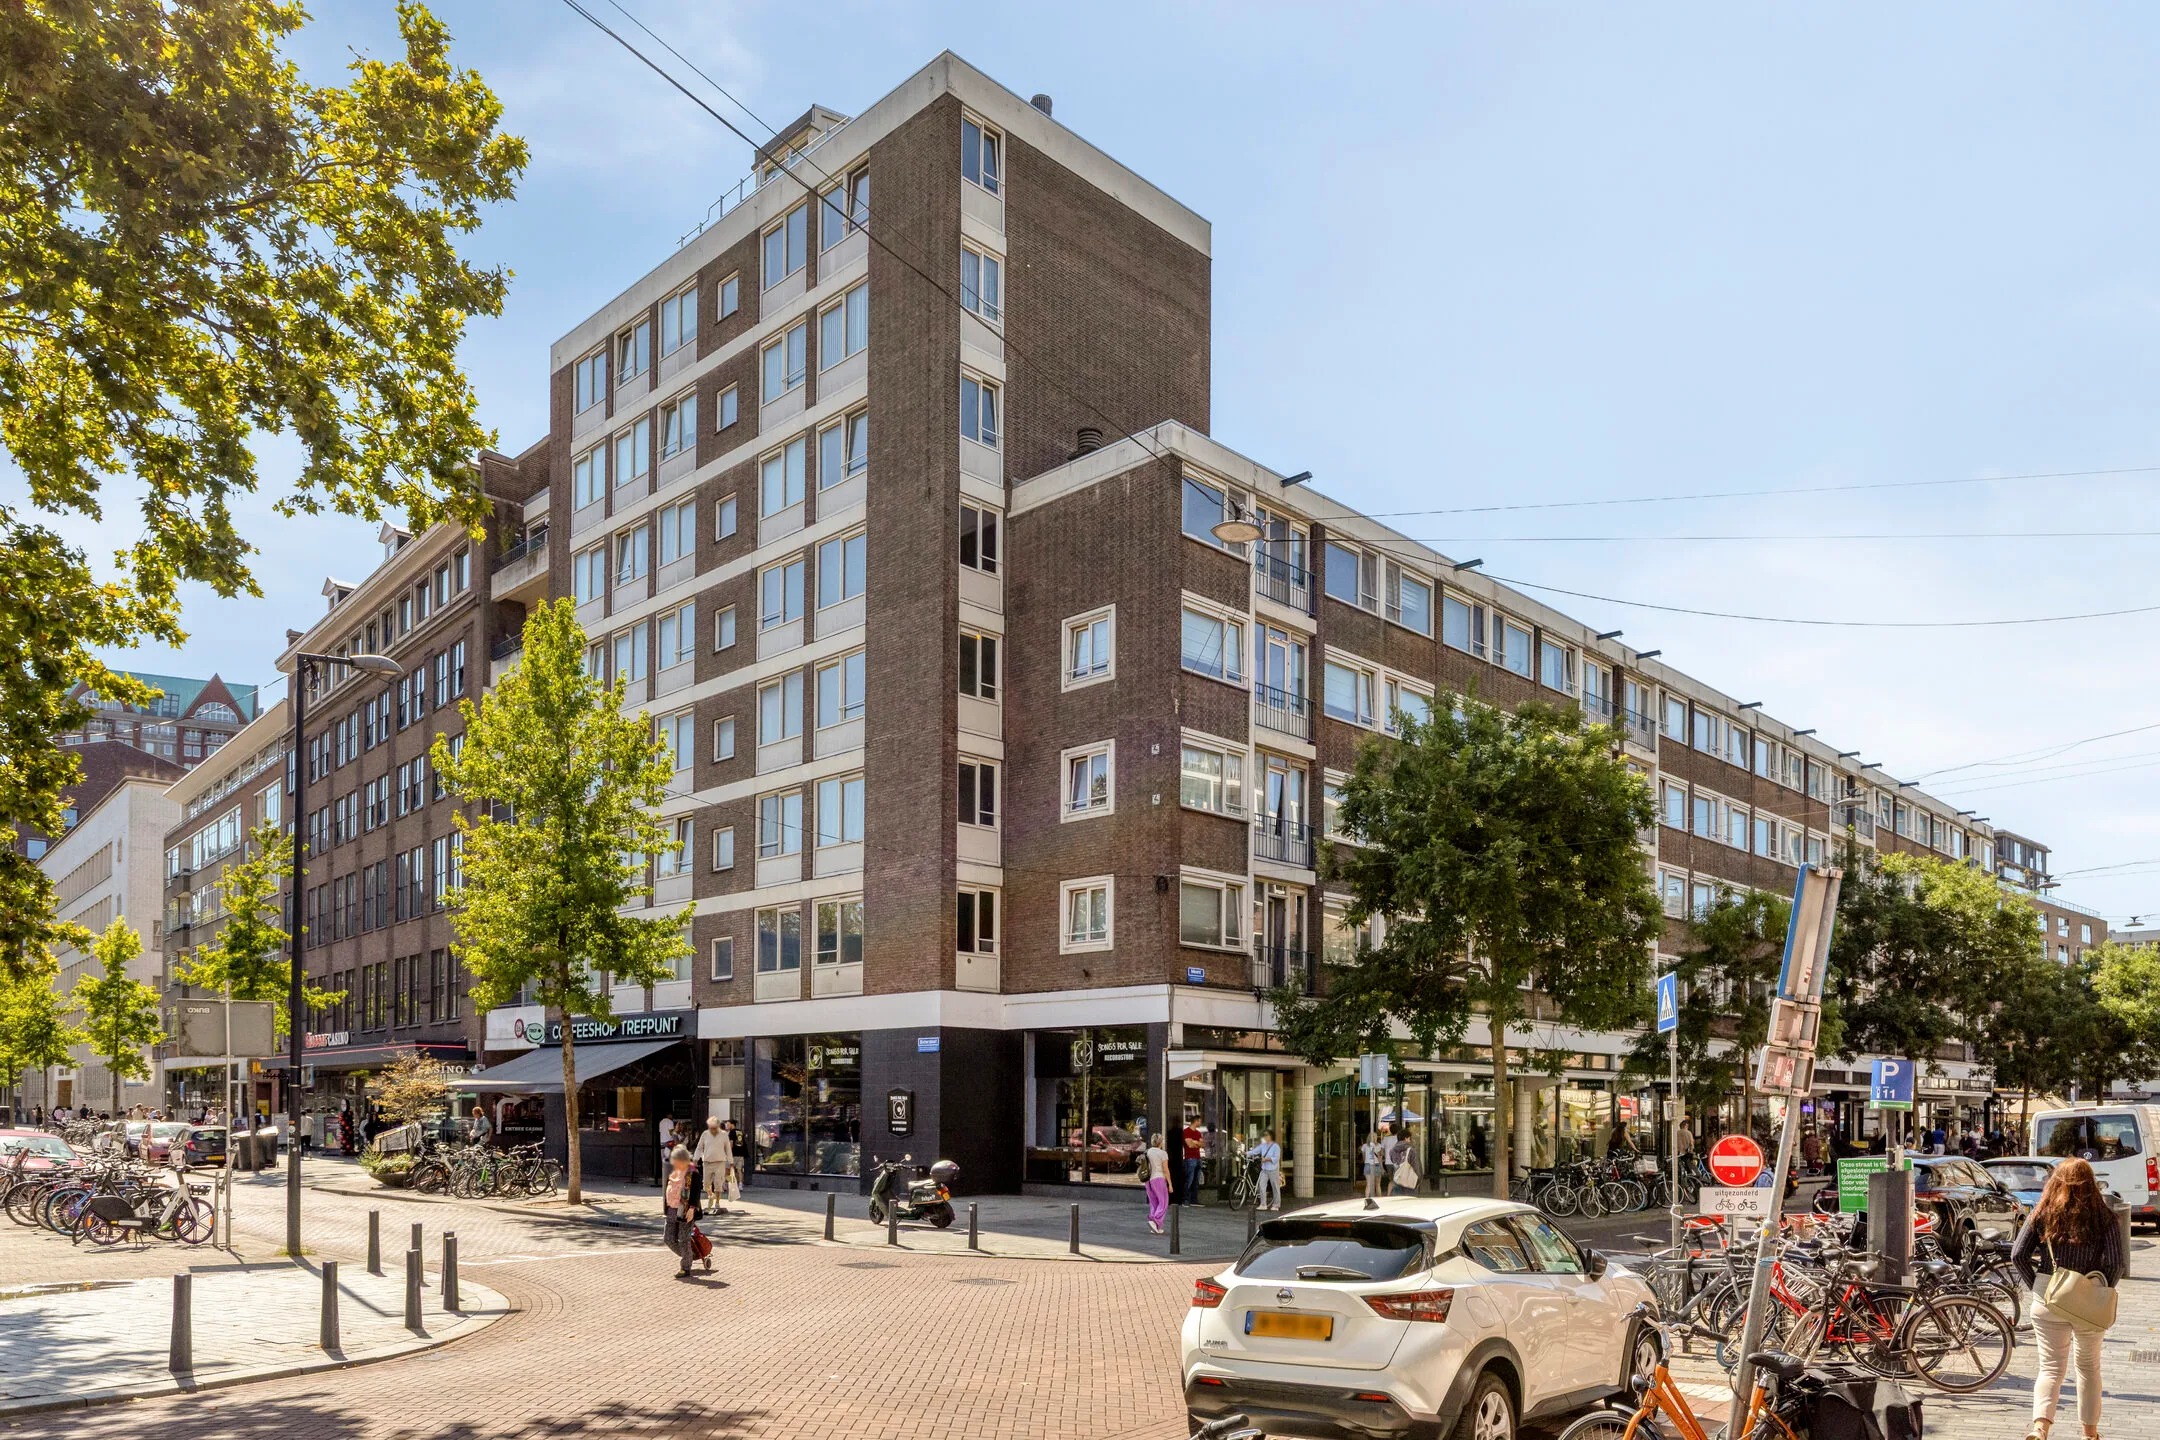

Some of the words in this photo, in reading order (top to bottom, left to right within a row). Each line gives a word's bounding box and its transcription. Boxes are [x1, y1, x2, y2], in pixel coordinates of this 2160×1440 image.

[552, 1022, 617, 1040] COFEESHOP
[621, 1017, 679, 1036] TREFPUNT
[1097, 1043, 1116, 1052] SONGS
[1117, 1042, 1128, 1050] FOR
[1128, 1041, 1143, 1050] SALE
[1881, 1061, 1899, 1085] P
[1714, 1190, 1759, 1198] uitgezonderd
